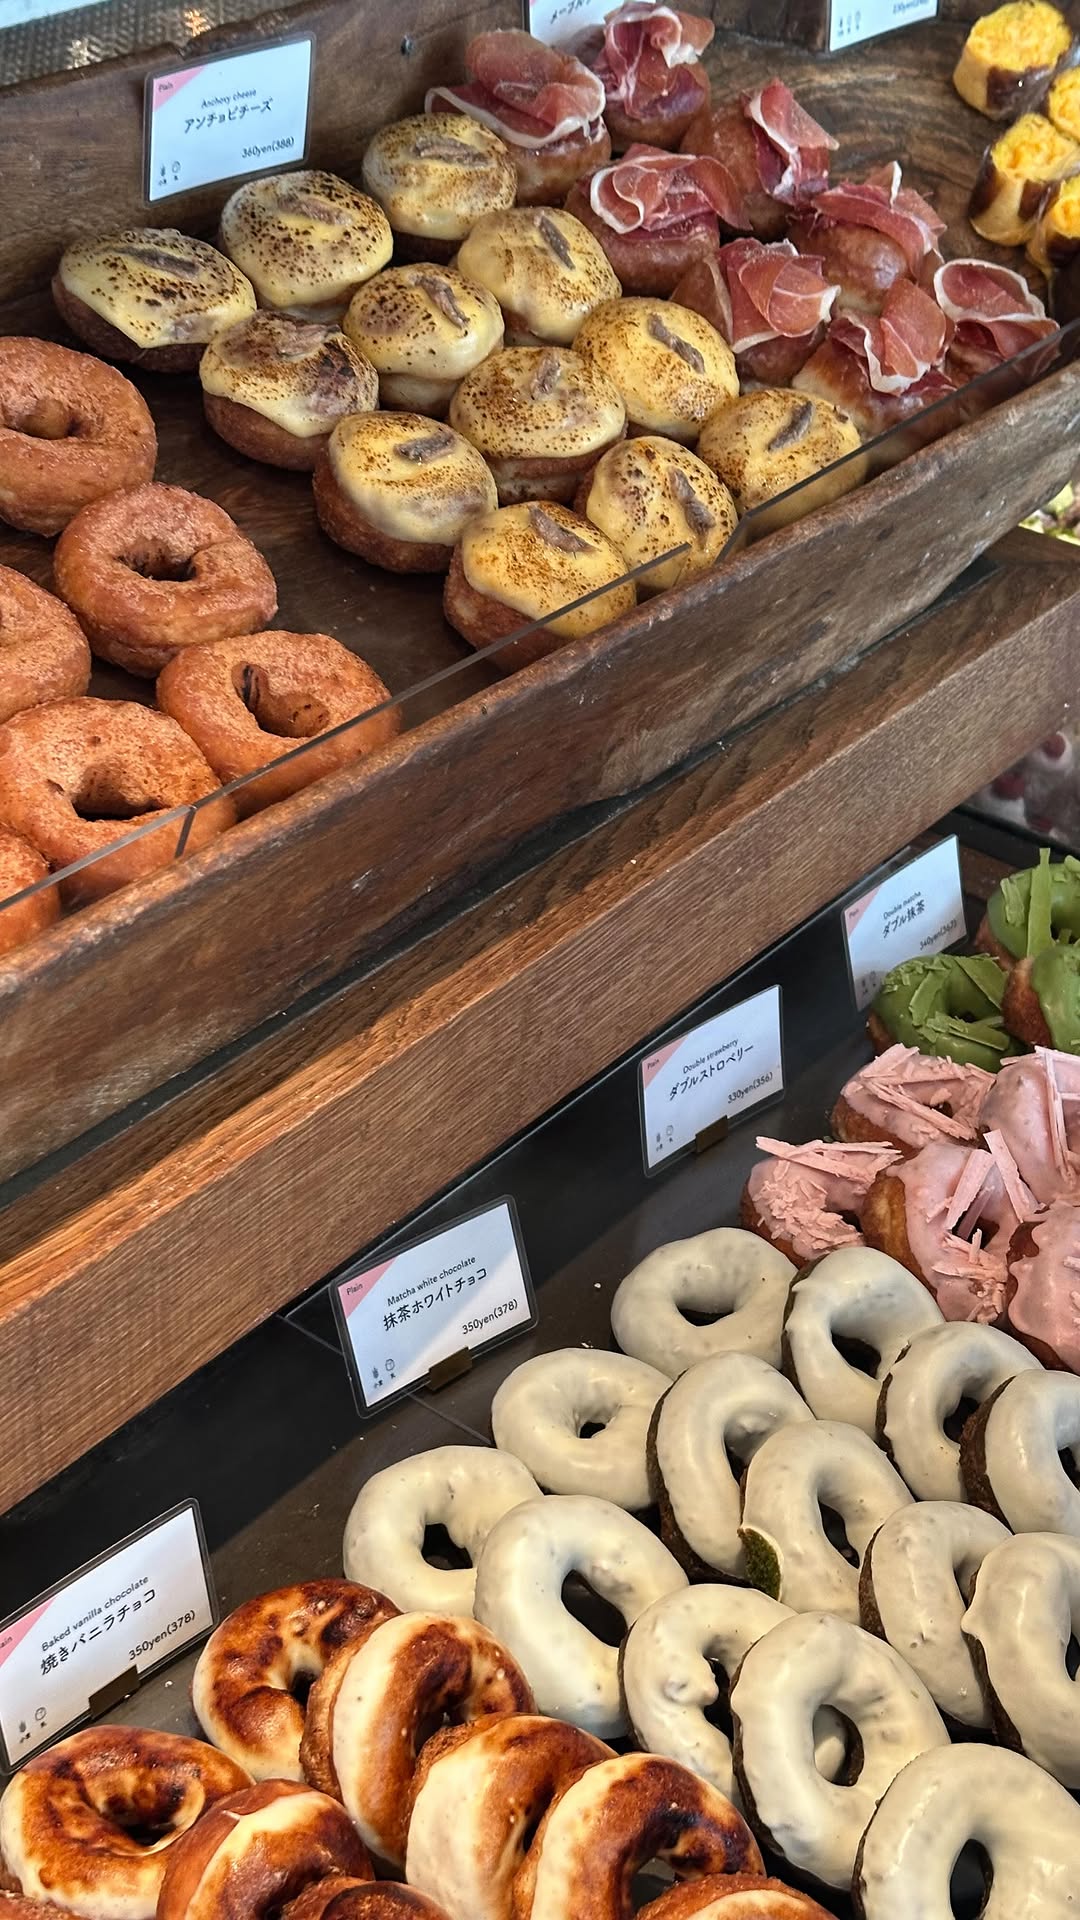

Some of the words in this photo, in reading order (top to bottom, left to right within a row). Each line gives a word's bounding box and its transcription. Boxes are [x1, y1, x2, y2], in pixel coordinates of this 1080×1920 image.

[184, 97, 273, 134] アンチョビチーズ
[201, 95, 231, 109] Anchovy
[232, 88, 257, 101] cheese
[241, 136, 295, 159] 360yen(388)
[883, 904, 902, 920] Double
[883, 899, 926, 938] ダブル抹茶
[647, 1058, 660, 1070] Plain
[669, 1045, 754, 1101] ダブルストロベリー
[683, 1057, 706, 1075] Double
[706, 1038, 739, 1064] strawberry
[727, 1071, 774, 1104] 330yen(356)
[346, 1282, 363, 1296] Plain
[383, 1267, 487, 1332] 抹茶ホワイトチョコ
[387, 1287, 416, 1307] Matcha
[416, 1274, 438, 1291] white
[439, 1255, 476, 1280] chocolate
[461, 1299, 518, 1335] 350yen(378)
[40, 1588, 156, 1676] 焼きバニラチョコ
[41, 1626, 71, 1652] Baked
[72, 1606, 103, 1630] vanilla
[104, 1575, 149, 1610] chocolate
[0, 1636, 13, 1649] ain
[128, 1609, 196, 1661] 350yen(378)
